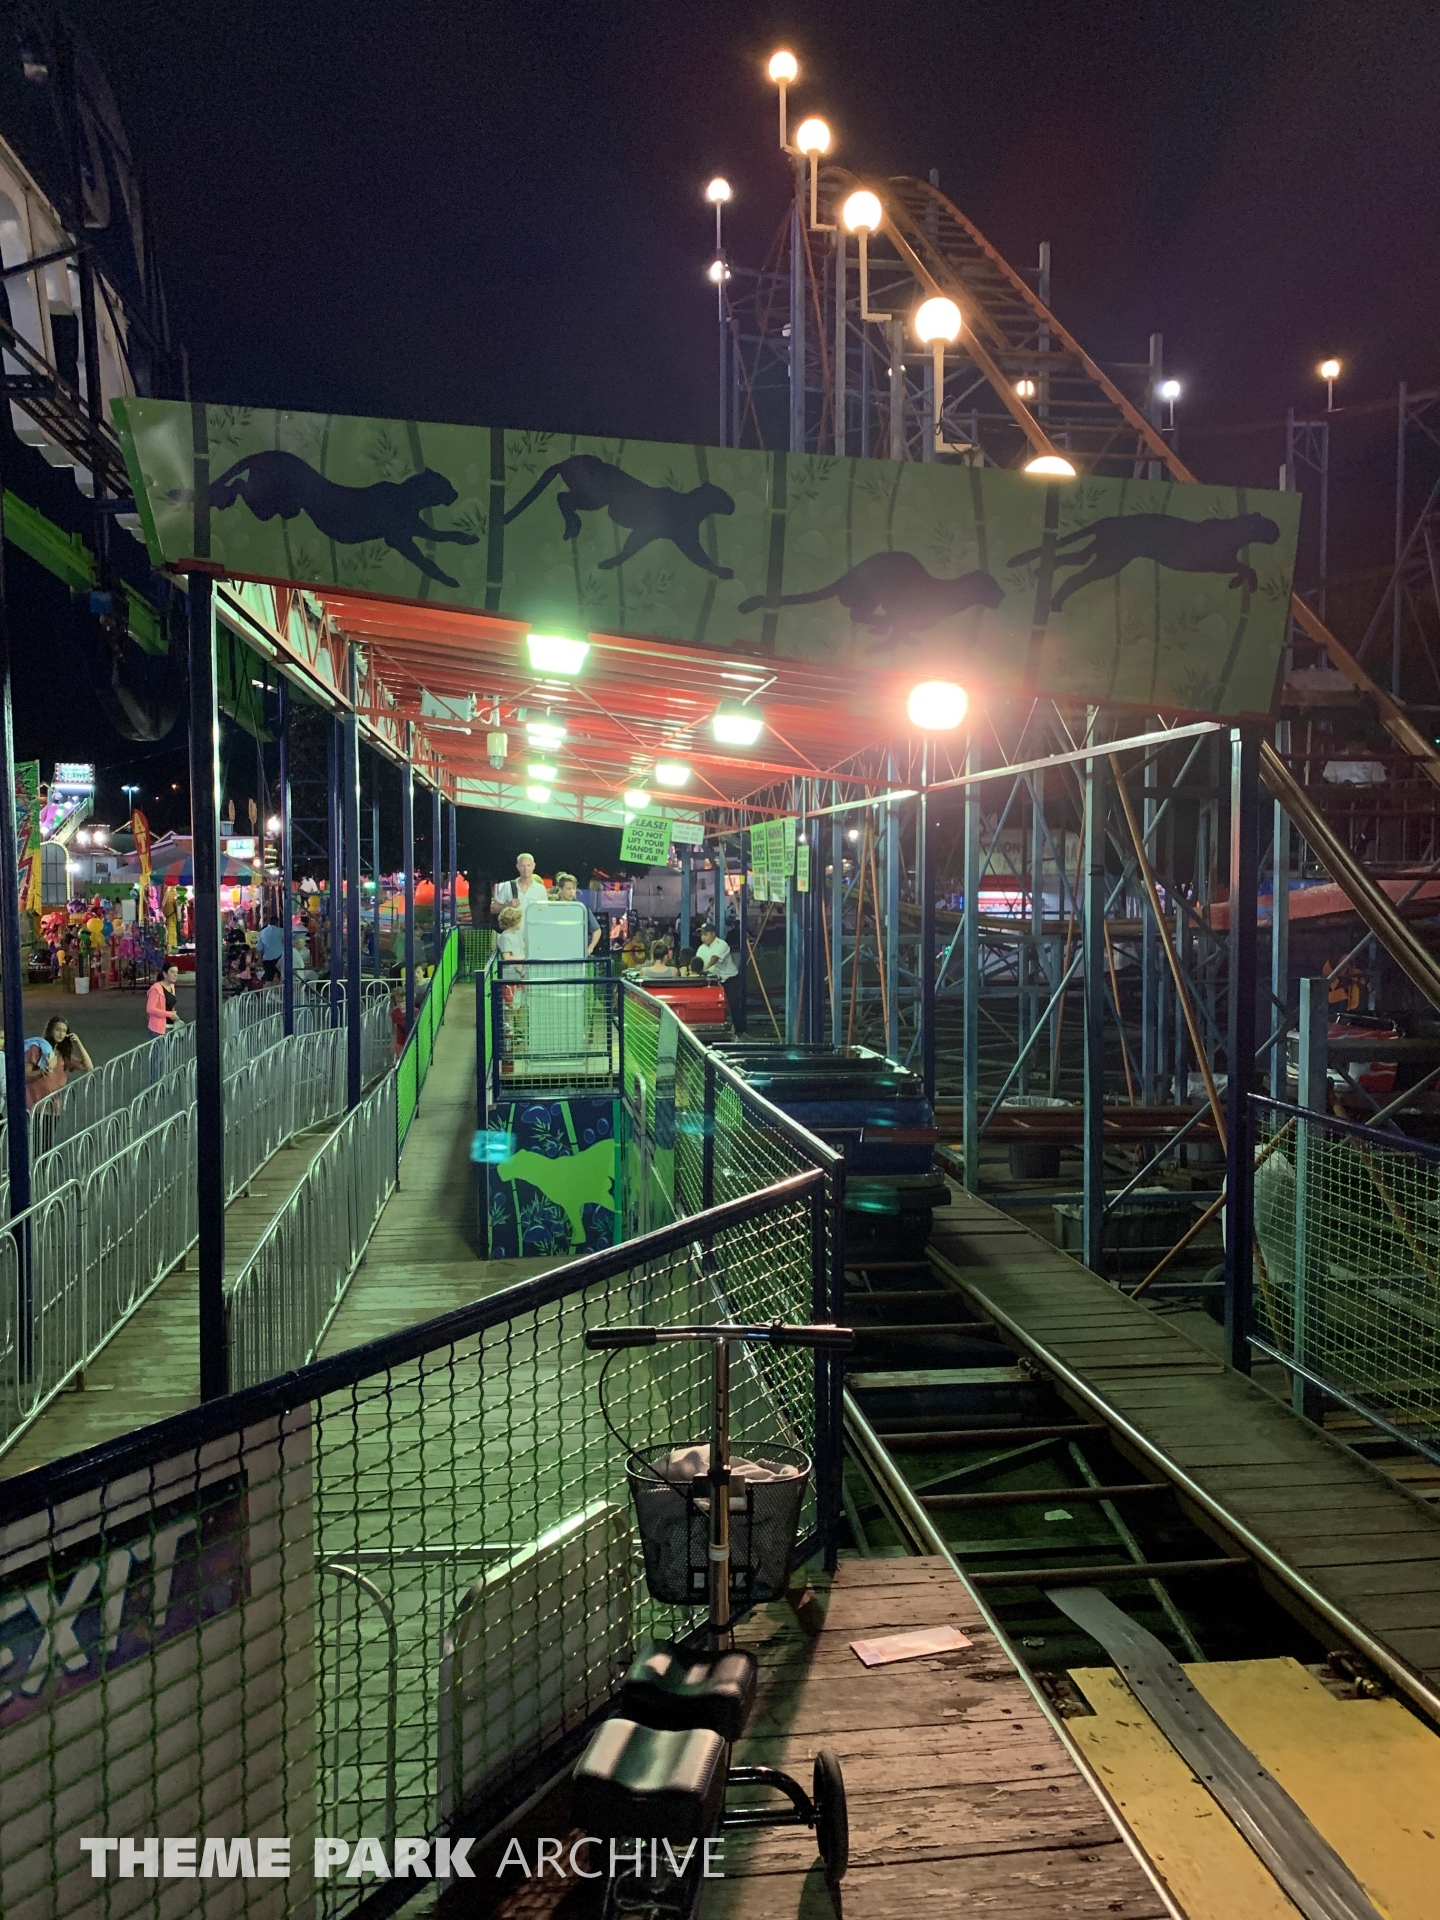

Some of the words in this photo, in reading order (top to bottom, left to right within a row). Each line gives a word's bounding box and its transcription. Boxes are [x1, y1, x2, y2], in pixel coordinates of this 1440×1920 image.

[630, 818, 668, 831] PLEASE!
[646, 832, 663, 840] NOT
[628, 836, 641, 844] LIFT
[644, 839, 665, 848] YOUR
[626, 844, 653, 853] HANDS
[630, 852, 643, 860] THE
[646, 854, 659, 862] AIR
